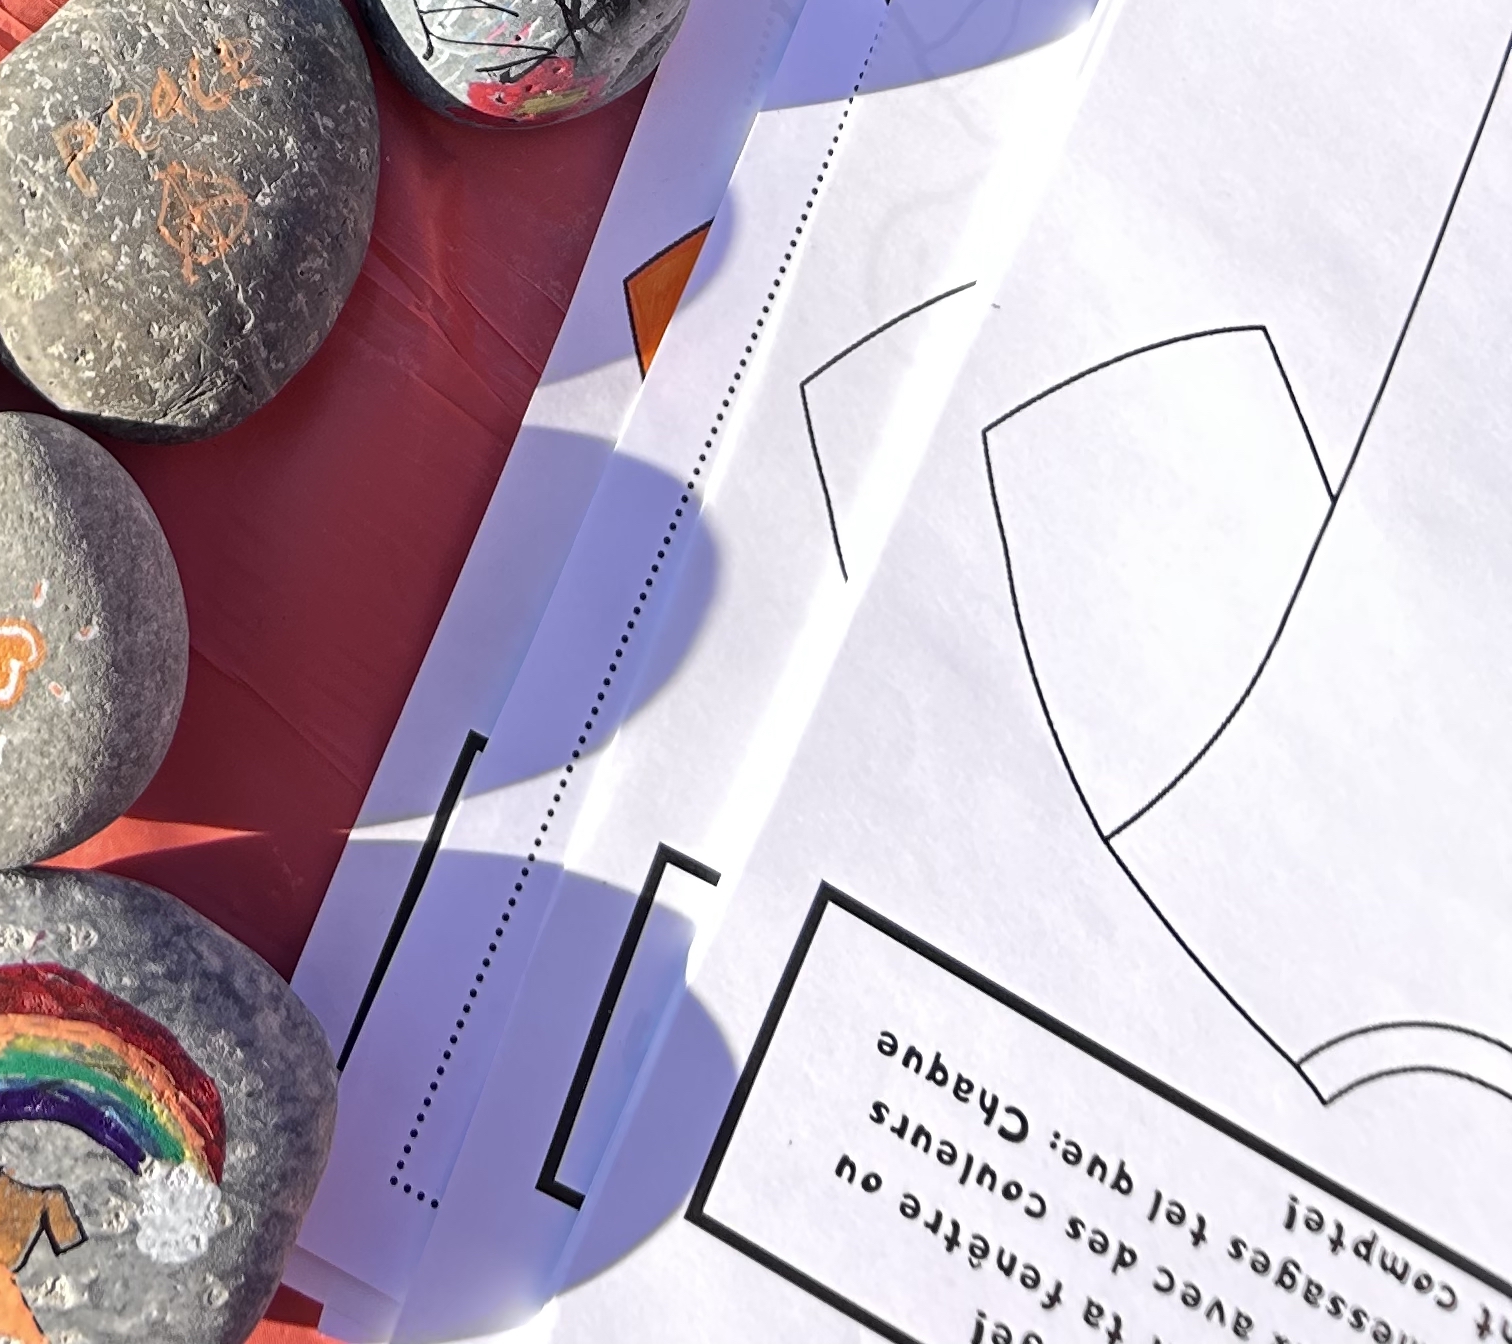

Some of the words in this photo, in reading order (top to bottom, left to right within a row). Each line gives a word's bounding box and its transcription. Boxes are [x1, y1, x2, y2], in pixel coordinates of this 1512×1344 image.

[863, 1023, 1040, 1147] Chaque
[831, 1153, 886, 1196] ou
[859, 1096, 1053, 1225] couleurs
[1042, 1124, 1142, 1201] que:
[892, 1191, 1066, 1313] fenêtre
[1056, 1212, 1141, 1279] des
[1140, 1188, 1215, 1249] tel
[1273, 1188, 1467, 1319] compte!
[1145, 1263, 1257, 1342] avec
